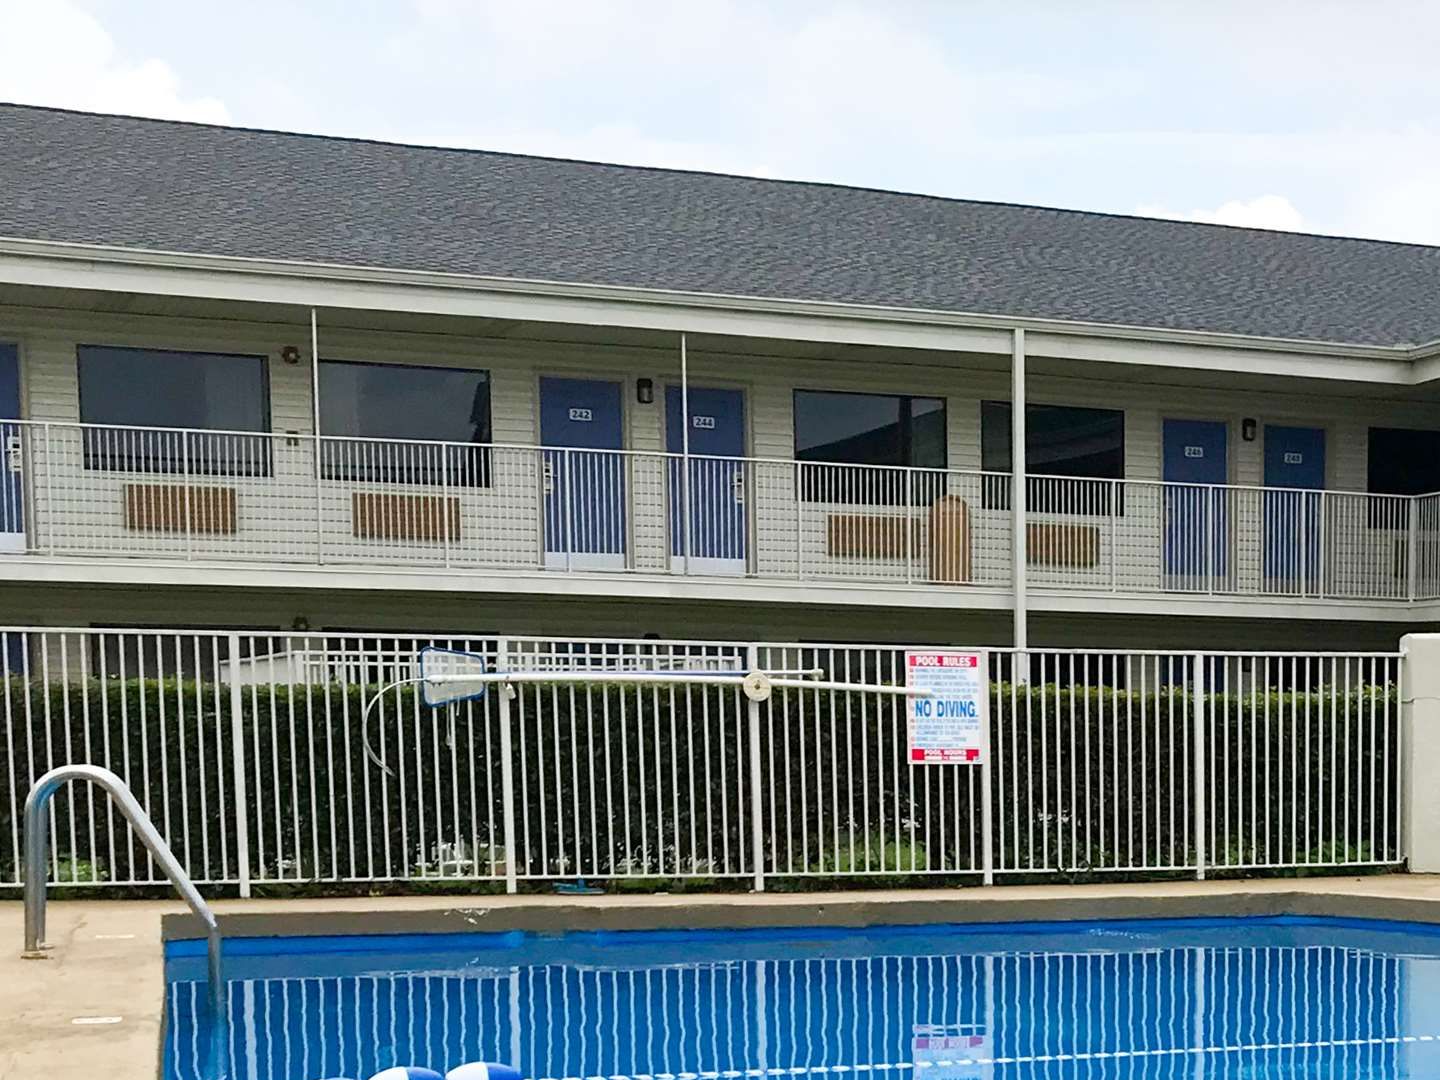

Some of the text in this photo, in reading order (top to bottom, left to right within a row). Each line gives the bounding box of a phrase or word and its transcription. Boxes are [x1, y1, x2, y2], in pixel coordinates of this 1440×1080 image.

[571, 410, 590, 419] 242
[915, 656, 972, 666] POOL RULES
[915, 700, 932, 717] NO
